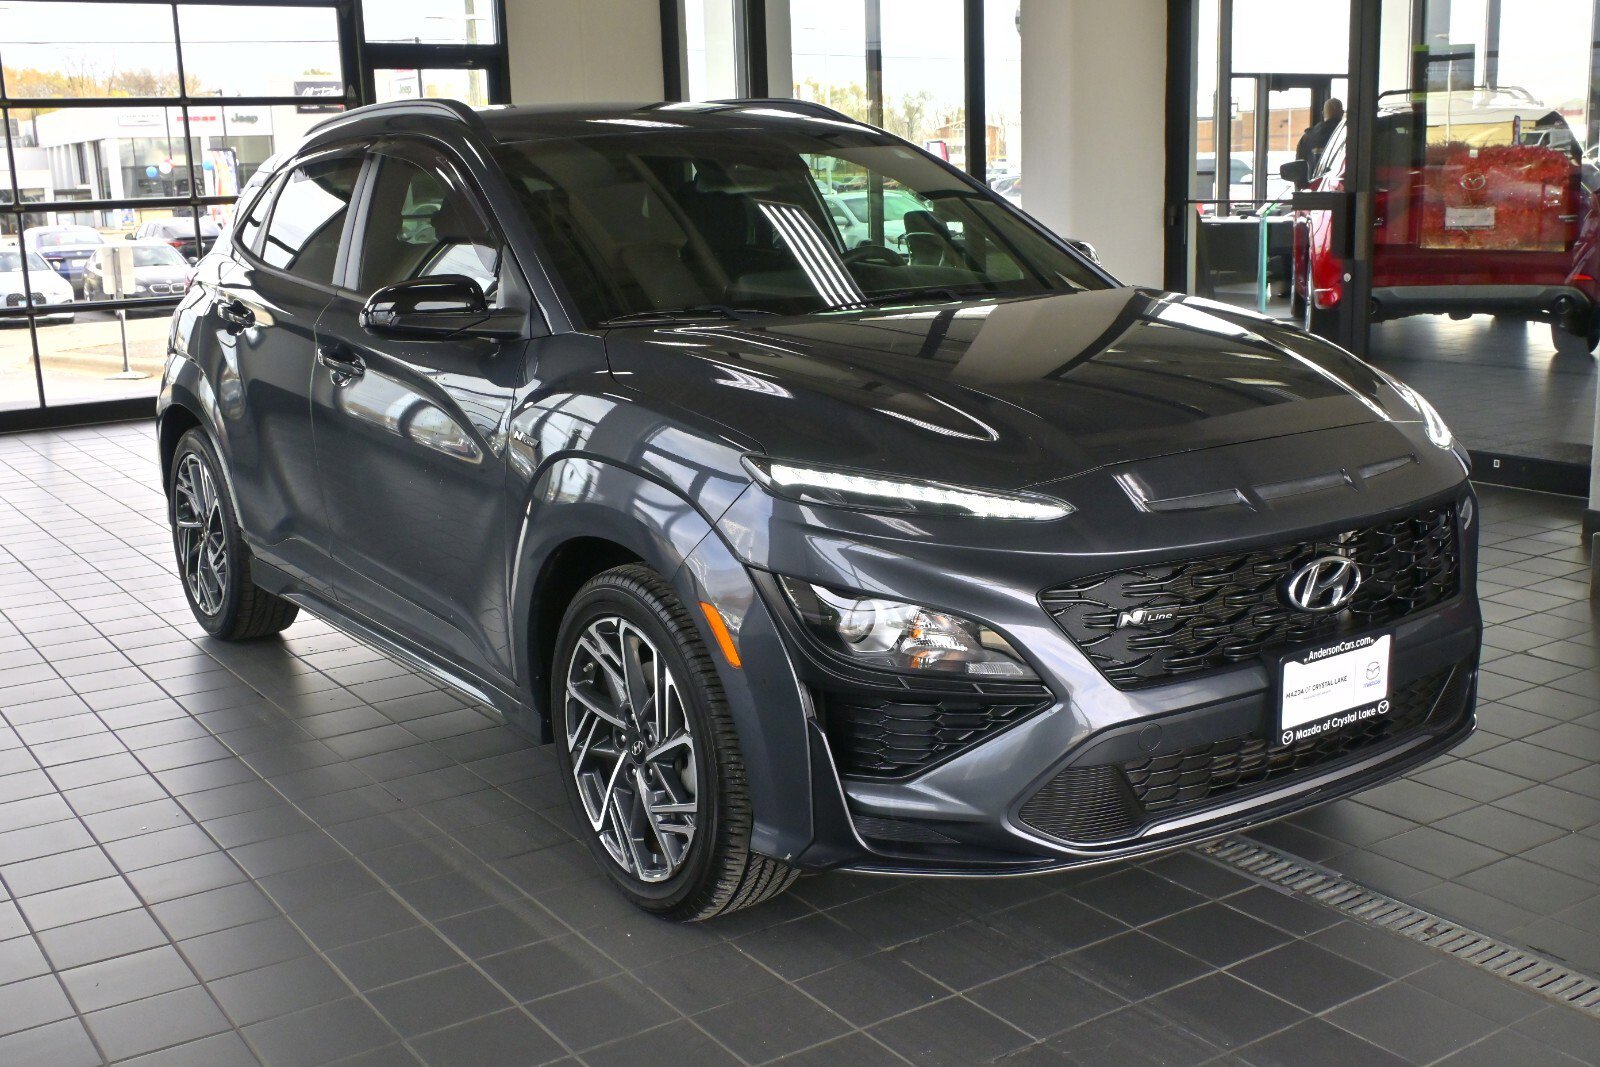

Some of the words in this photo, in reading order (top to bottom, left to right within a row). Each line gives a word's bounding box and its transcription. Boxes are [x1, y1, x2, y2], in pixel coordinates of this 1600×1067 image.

[231, 113, 258, 125] Jeep
[1148, 613, 1173, 621] Line
[1308, 637, 1371, 660] AndersonCars.com
[1286, 688, 1304, 699] MAZDA
[1312, 680, 1334, 691] CRYSTAL
[1334, 675, 1348, 685] LAKE
[1295, 724, 1321, 740] Mazda
[1322, 720, 1331, 731] of
[1331, 711, 1357, 728] Crystal
[1358, 707, 1376, 719] Lake
